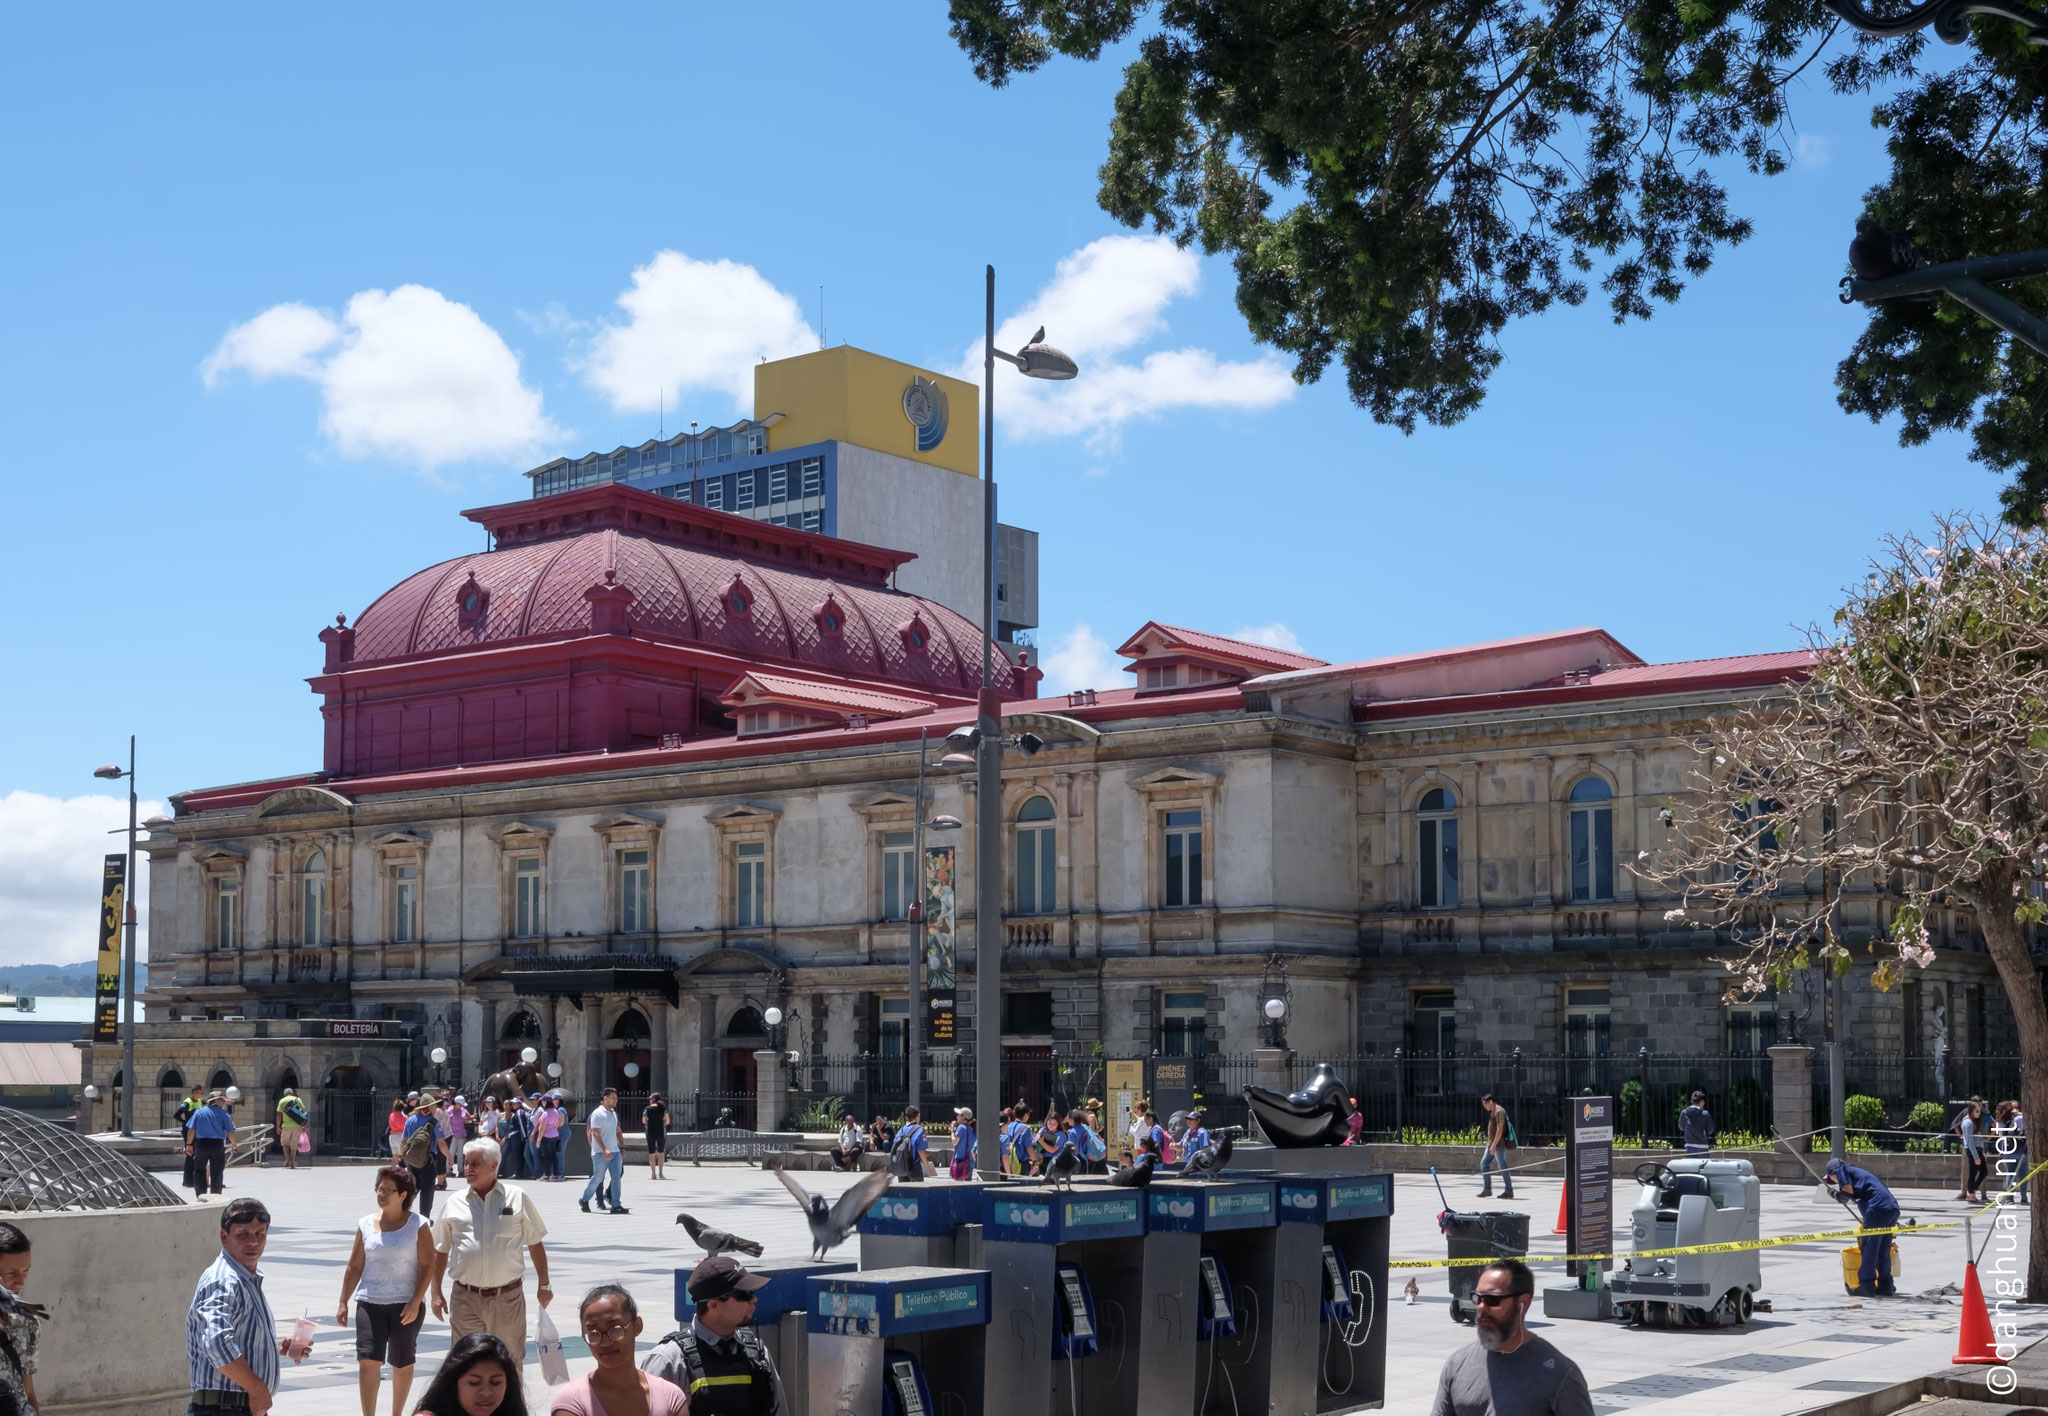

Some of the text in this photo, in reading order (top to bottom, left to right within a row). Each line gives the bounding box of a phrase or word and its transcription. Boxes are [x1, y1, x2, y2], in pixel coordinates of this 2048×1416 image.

[333, 1021, 379, 1034] BOLETERÍA
[1157, 1064, 1187, 1072] JIMÉNEZ
[1217, 1196, 1263, 1207] Teléfono Público
[1074, 1202, 1128, 1216] Teléfono Público
[905, 1290, 968, 1305] Teléfono Público
